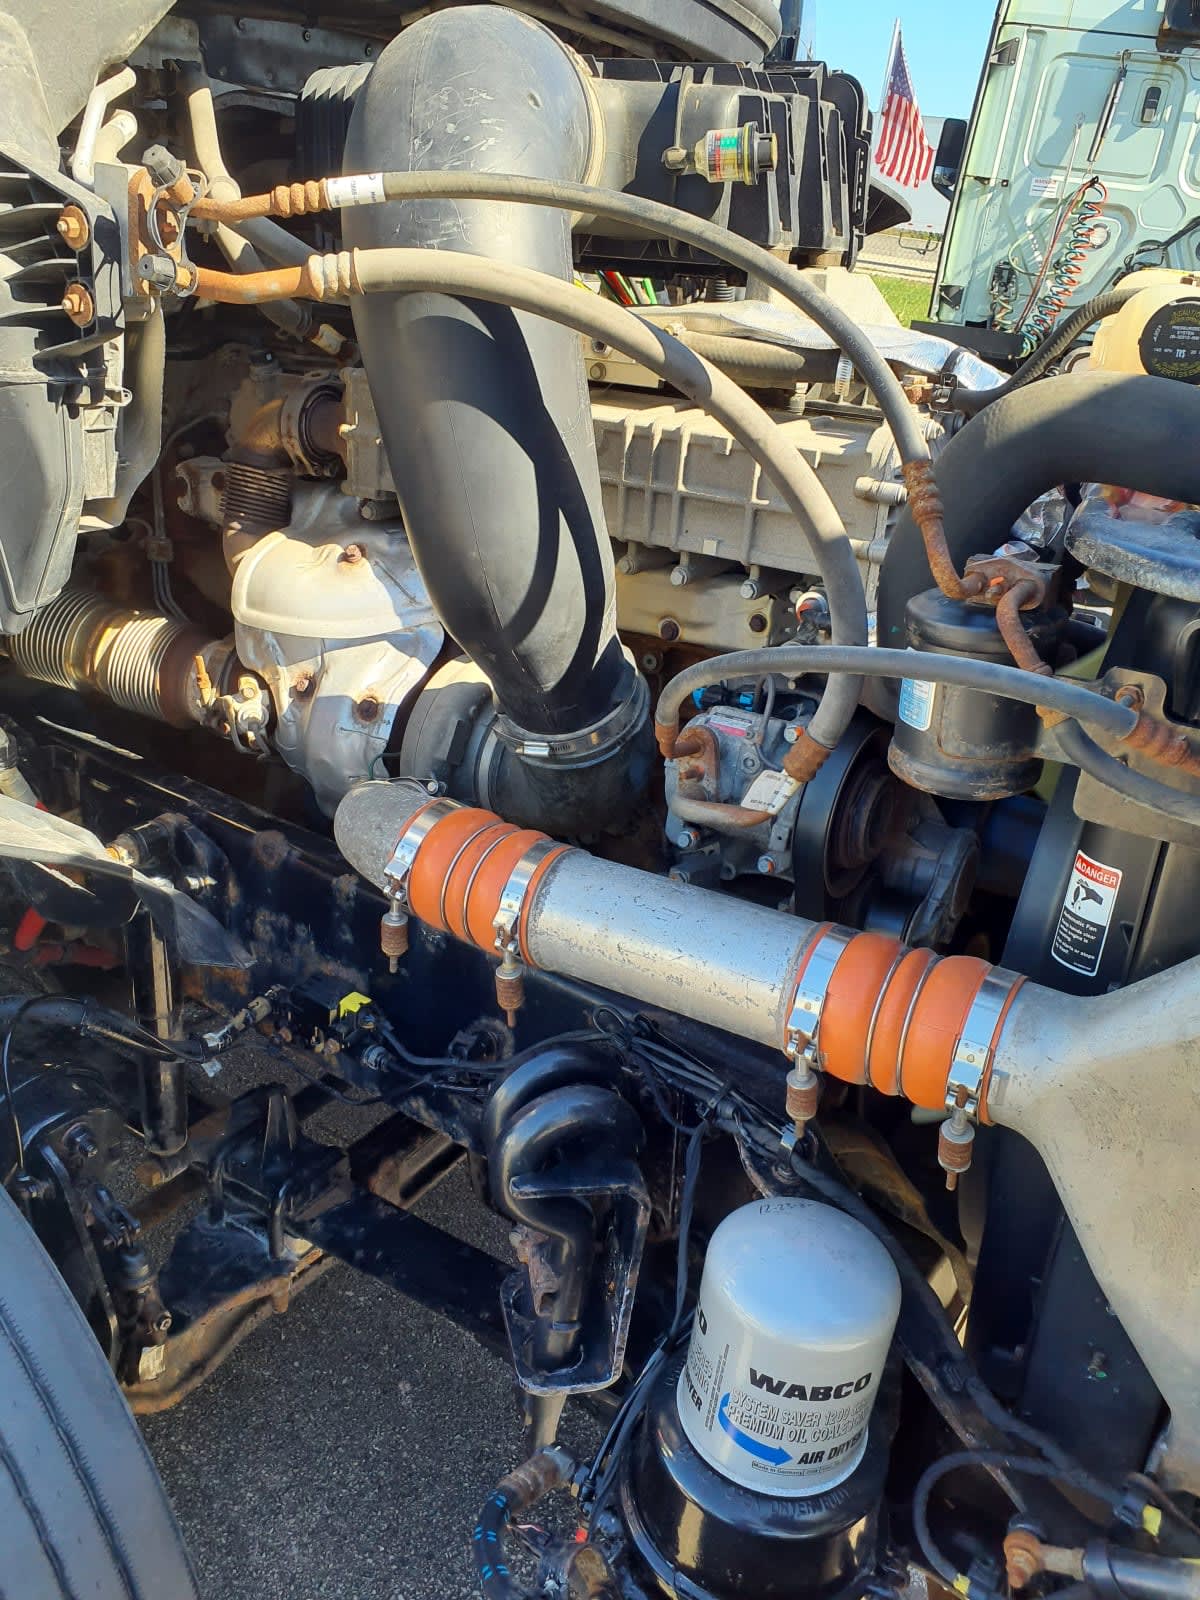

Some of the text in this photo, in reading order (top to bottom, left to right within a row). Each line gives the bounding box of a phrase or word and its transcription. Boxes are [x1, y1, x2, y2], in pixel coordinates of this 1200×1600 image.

[1081, 864, 1117, 885] DANGER
[1082, 931, 1097, 940] clear
[1085, 923, 1098, 933] Fan
[750, 1367, 872, 1402] WABCO
[730, 1386, 780, 1423] SYSTEM
[782, 1407, 822, 1428] SAVER
[824, 1407, 851, 1426] 1200
[727, 1402, 785, 1441] PREMIUM
[787, 1426, 807, 1443] OIL
[797, 1450, 826, 1465] AIR
